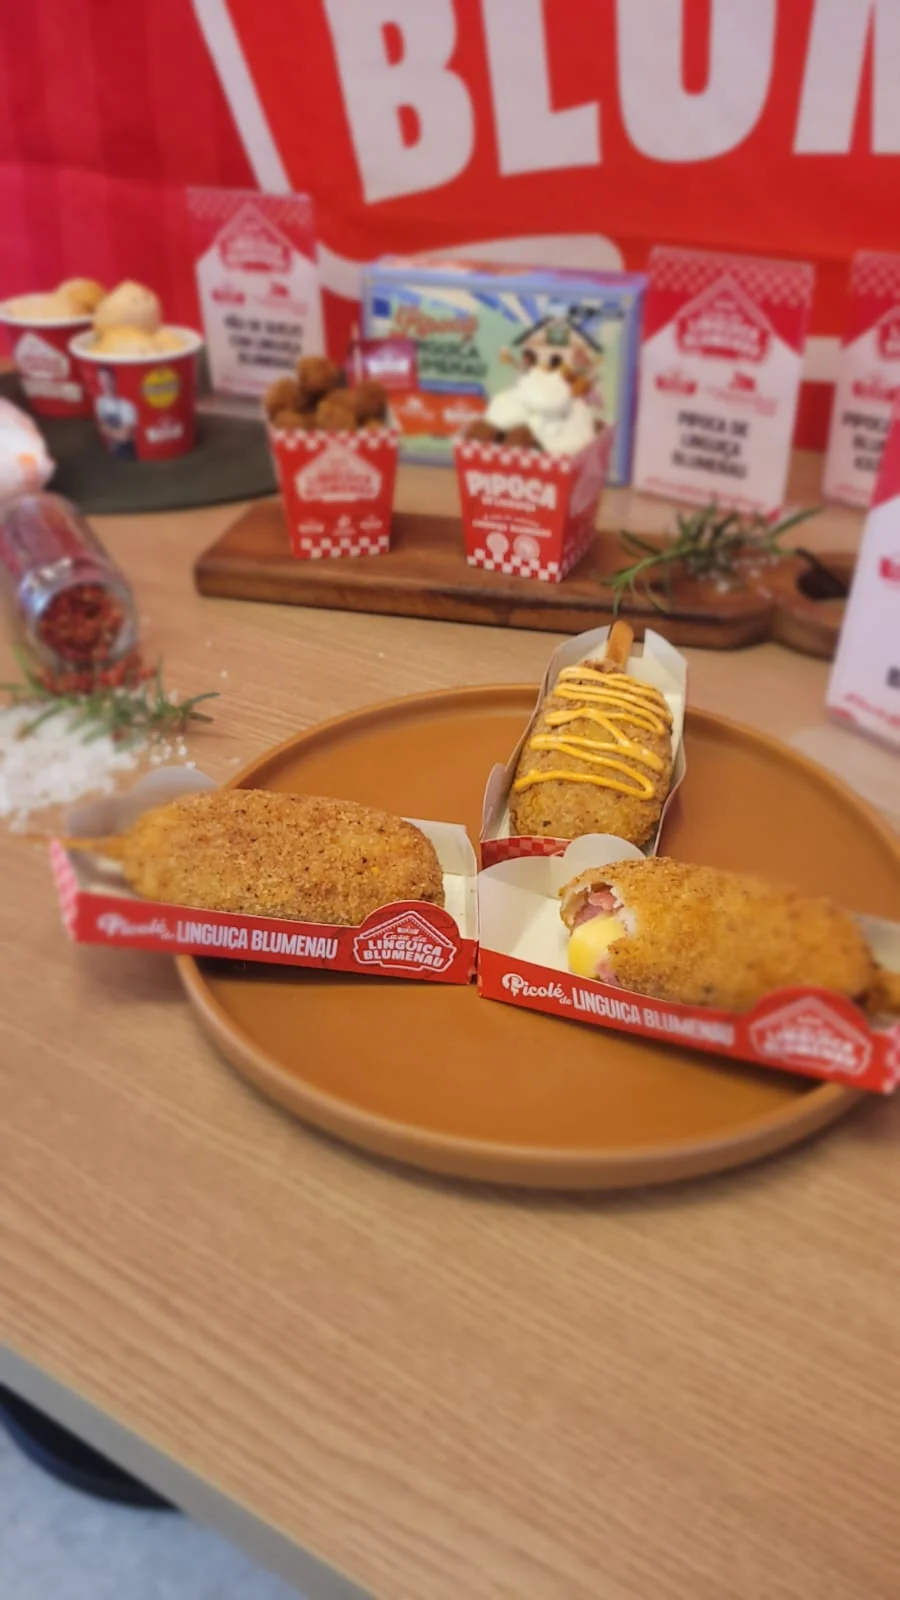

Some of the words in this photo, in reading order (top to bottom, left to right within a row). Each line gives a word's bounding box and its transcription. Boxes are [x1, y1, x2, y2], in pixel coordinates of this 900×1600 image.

[465, 469, 557, 510] PIPOCA
[177, 920, 248, 950] LINGUIÇA
[250, 932, 338, 960] BLUMENAU
[363, 950, 444, 968] BLUMENAU
[502, 972, 566, 997] Picolé
[559, 995, 573, 1006] de
[572, 987, 640, 1025] LINGUIÇA
[643, 1007, 734, 1047] BLUMENAU
